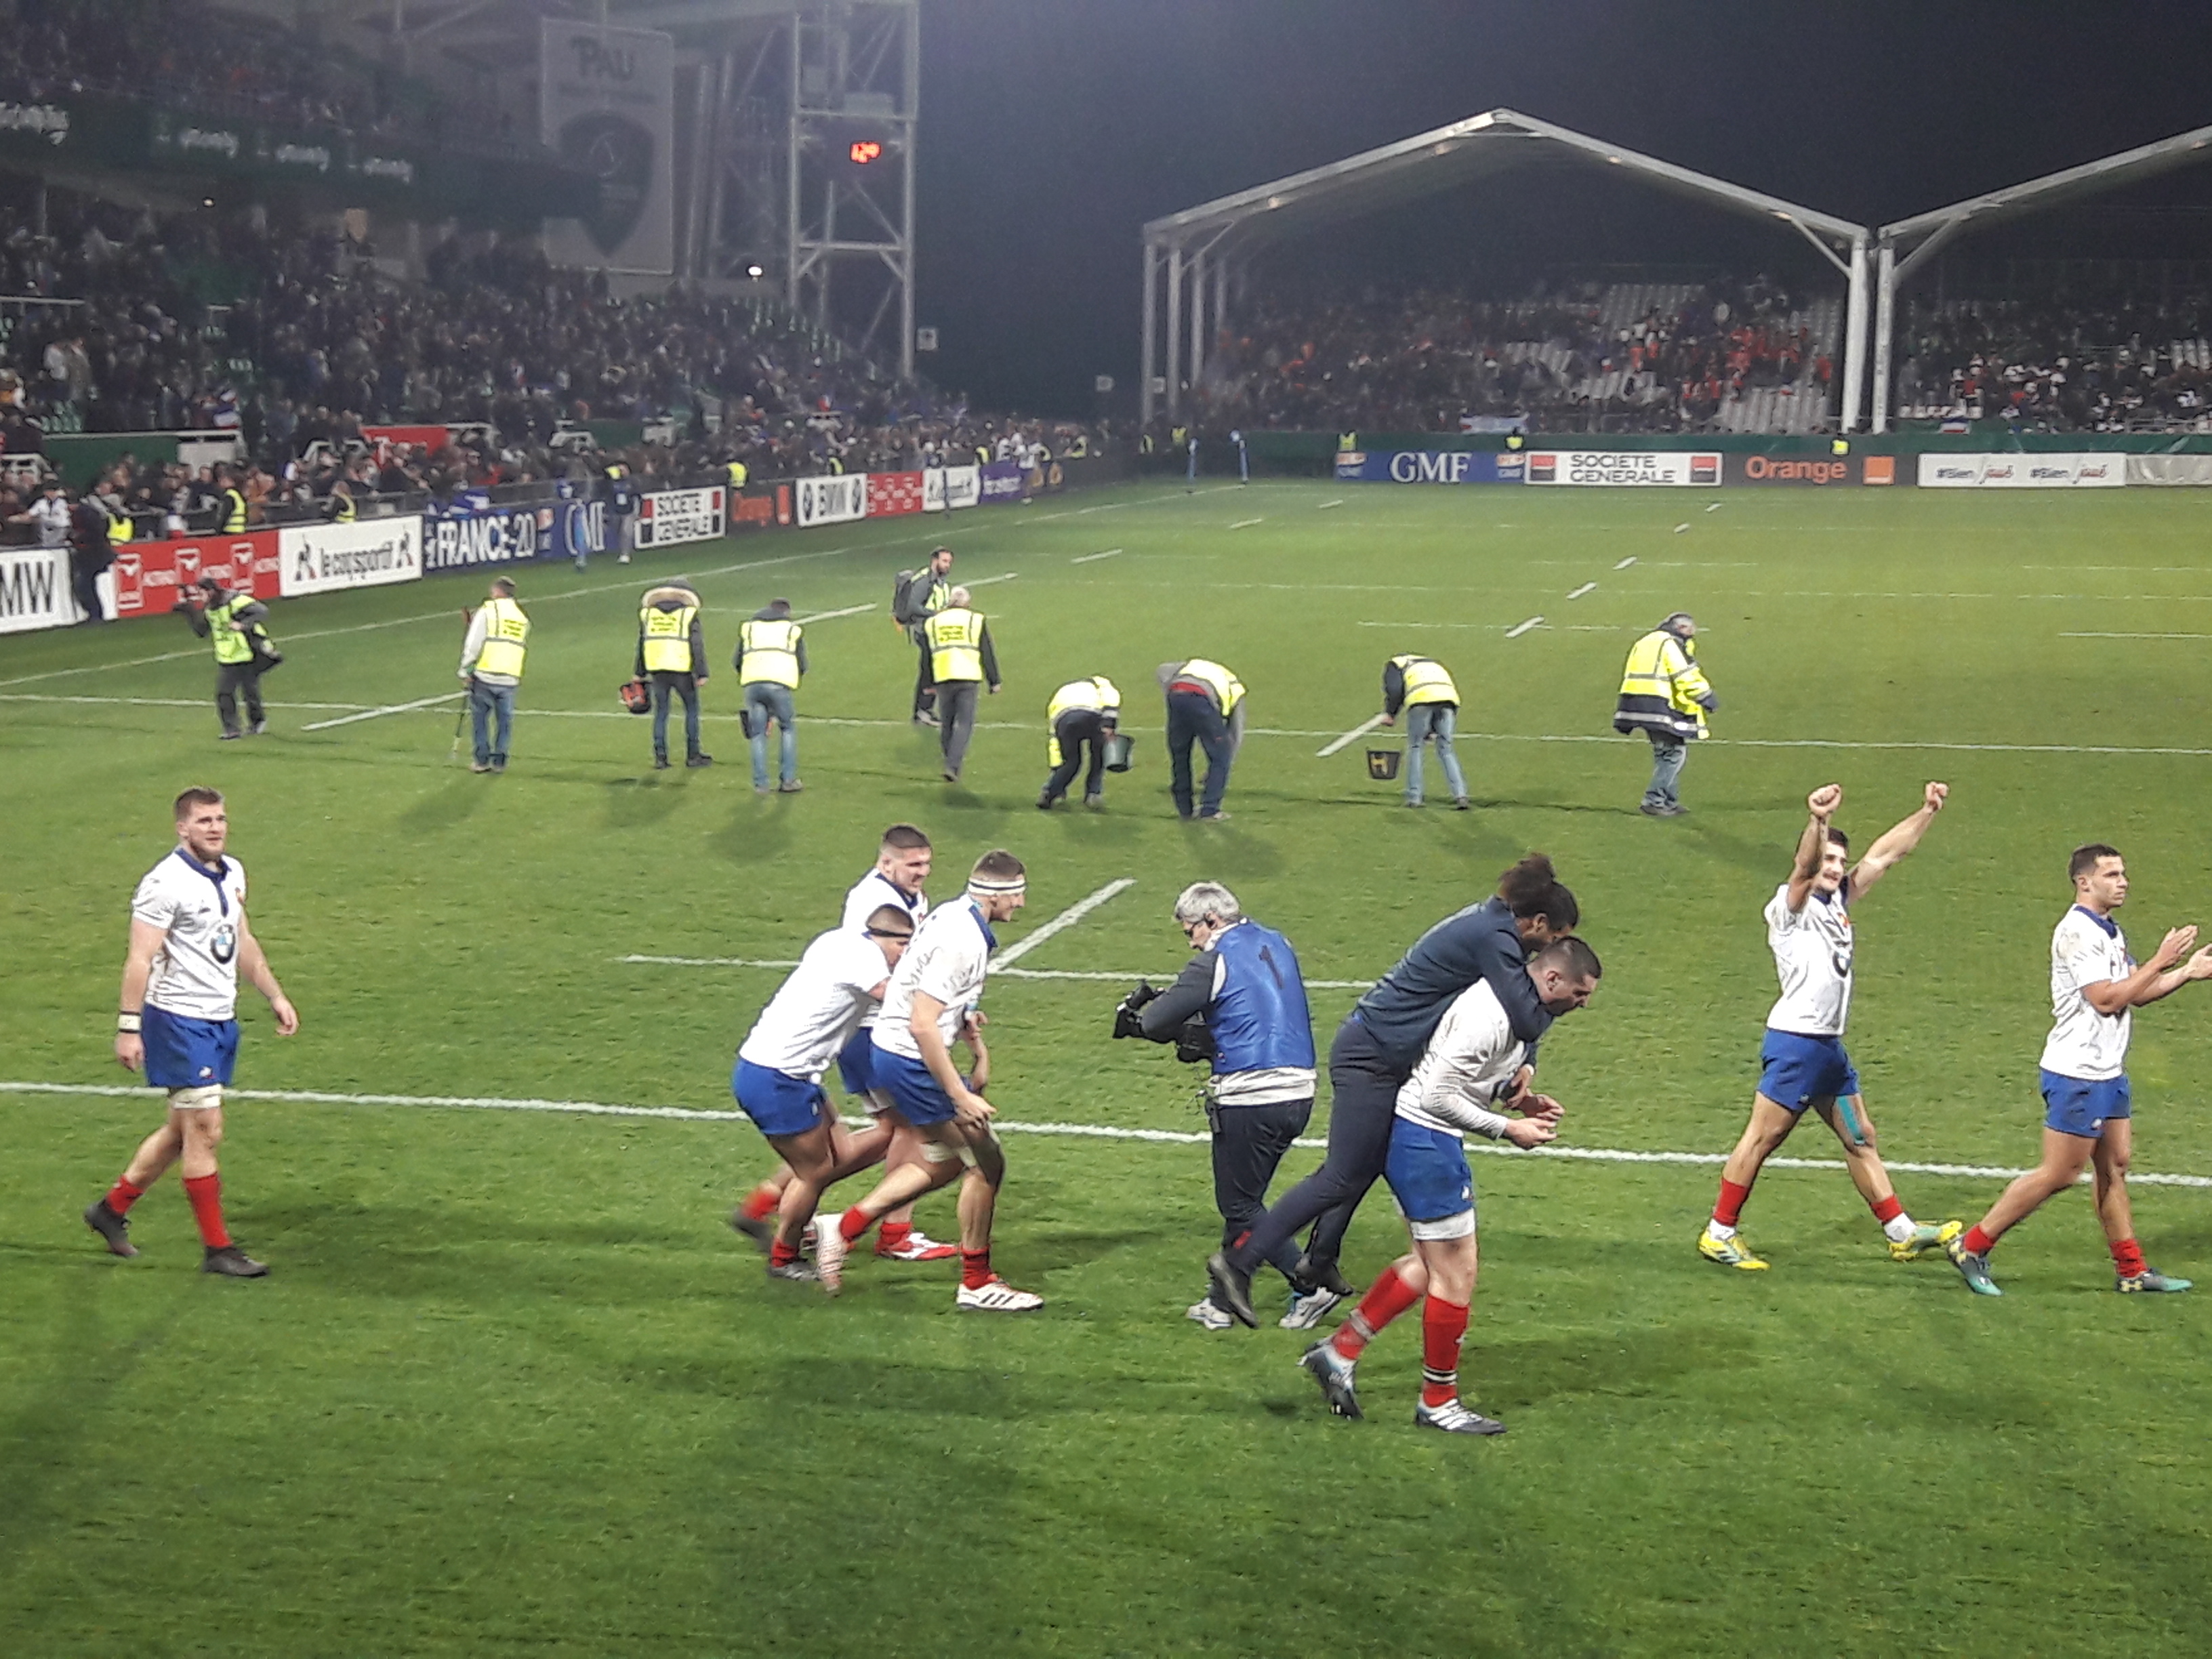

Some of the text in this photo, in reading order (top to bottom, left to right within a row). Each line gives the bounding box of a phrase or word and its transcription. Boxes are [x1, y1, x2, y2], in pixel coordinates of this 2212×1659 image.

[570, 37, 636, 82] PAU
[1390, 452, 1473, 483] GMF
[1570, 469, 1677, 483] GENERALE
[1744, 455, 1848, 485] Orange
[1258, 944, 1285, 990] 1
